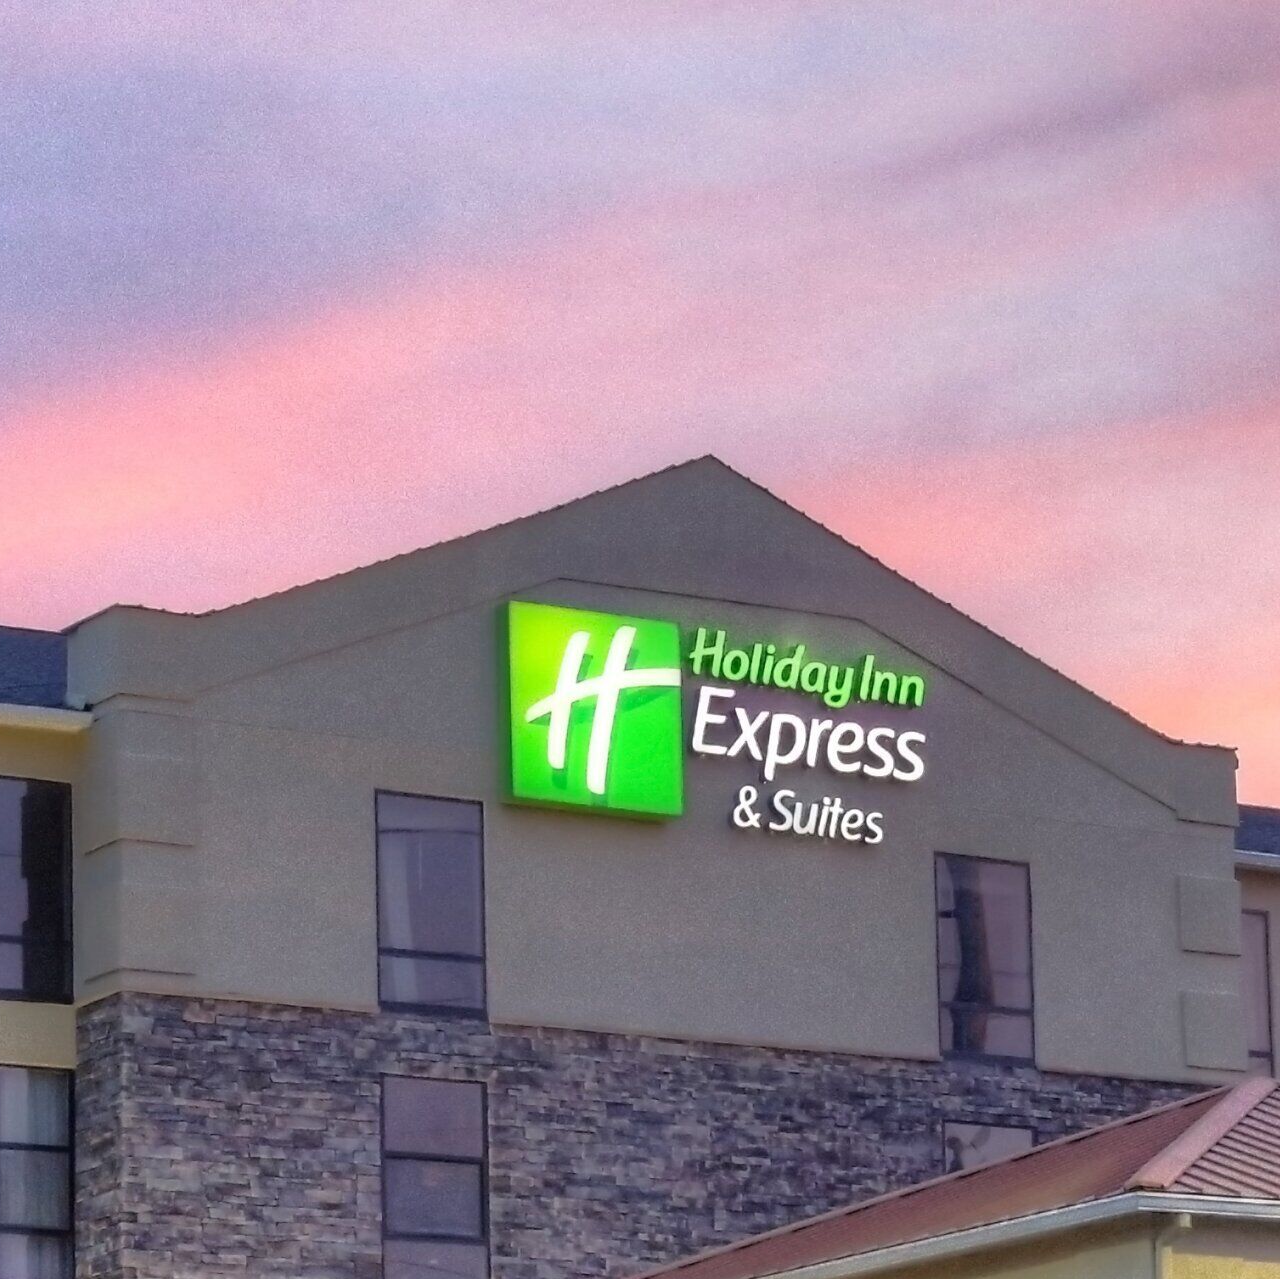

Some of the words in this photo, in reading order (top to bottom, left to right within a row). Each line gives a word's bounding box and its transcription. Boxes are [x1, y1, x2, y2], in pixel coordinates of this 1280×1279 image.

[689, 627, 854, 708] Holiday
[859, 654, 924, 706] Inn
[692, 685, 926, 781] Express
[733, 785, 761, 828] &
[769, 789, 884, 844] Suites
